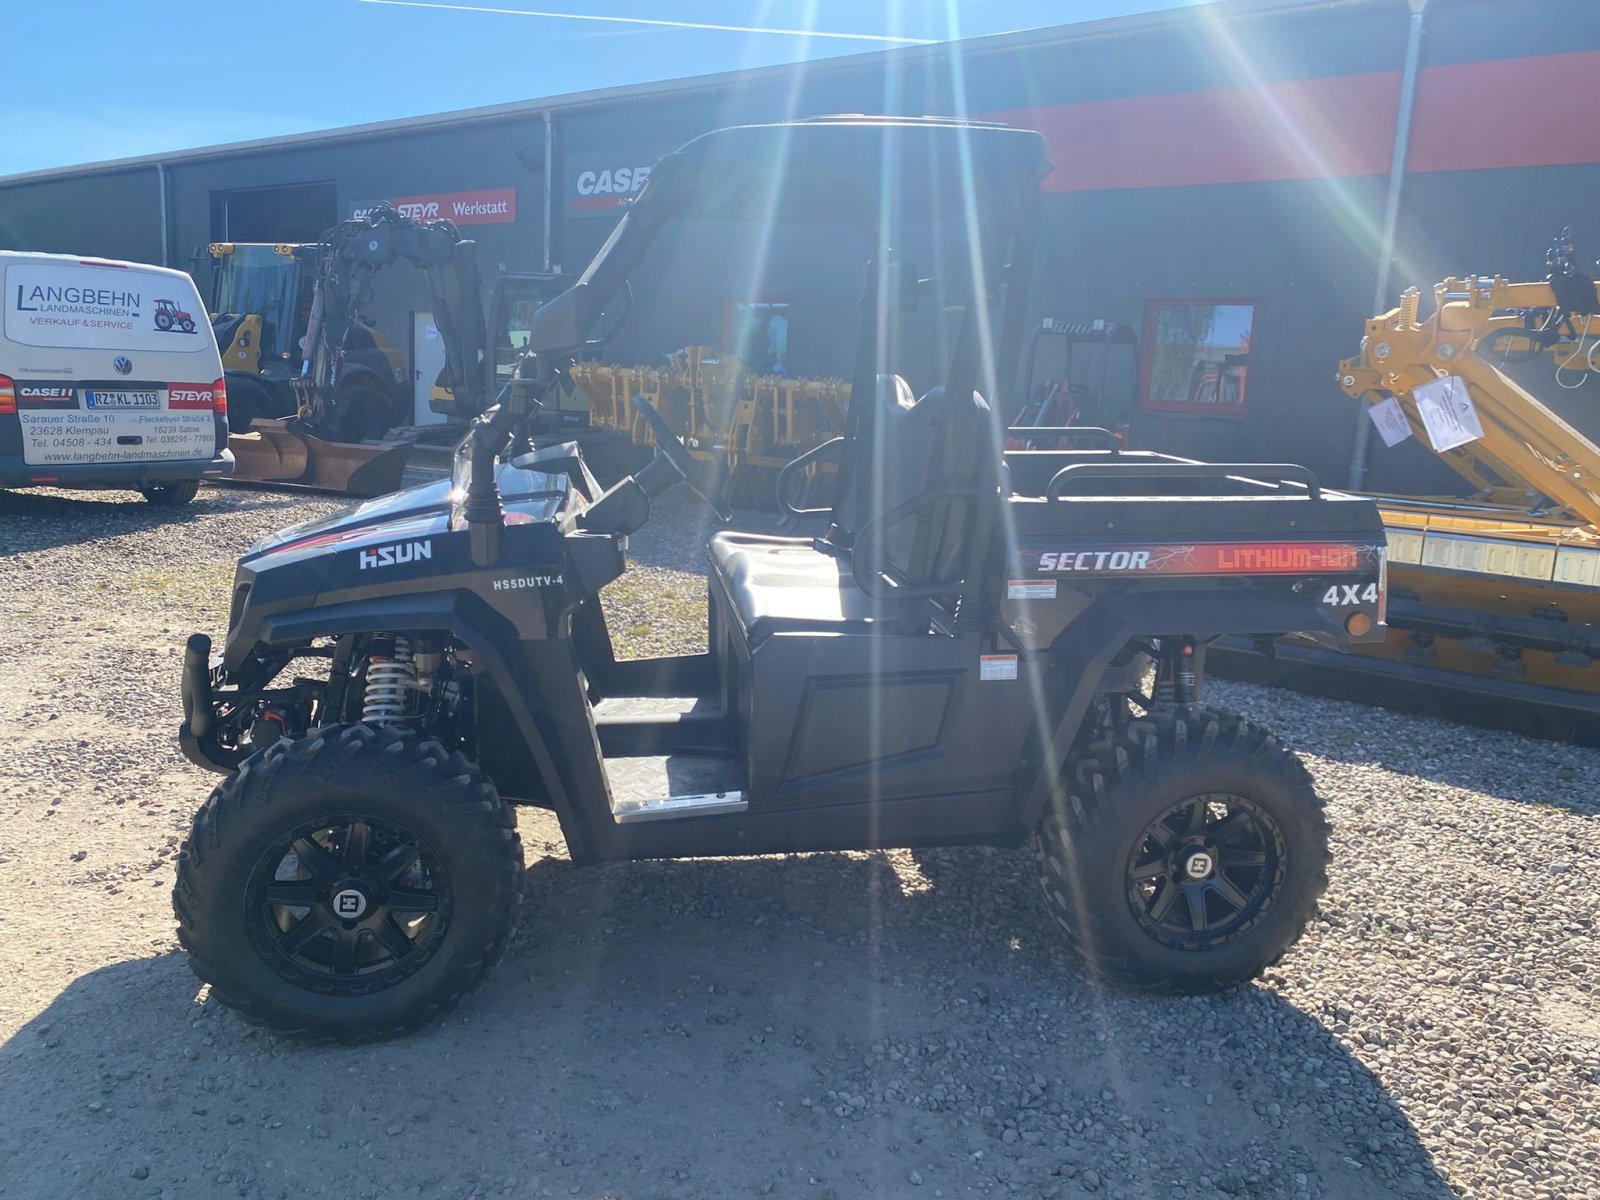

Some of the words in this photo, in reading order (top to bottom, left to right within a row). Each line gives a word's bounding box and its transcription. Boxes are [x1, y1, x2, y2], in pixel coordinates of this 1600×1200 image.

[398, 202, 439, 218] STEYR
[453, 200, 508, 216] Werkstatt
[17, 285, 140, 312] LANGBEHN
[40, 304, 129, 317] LANDMASCHINEN
[30, 317, 81, 326] VERKAUF
[83, 318, 89, 327] &
[90, 320, 133, 330] SERVICE
[20, 388, 59, 397] CASE
[170, 390, 213, 402] STEYR
[95, 393, 109, 405] RZ
[117, 393, 131, 405] KL
[133, 393, 158, 405] 1103
[22, 415, 63, 423] Sarauer
[67, 414, 99, 423] Straße
[103, 414, 115, 423] 10
[30, 427, 63, 435] 23628
[66, 427, 109, 436] Klempau
[154, 426, 177, 434] 18239
[178, 425, 200, 433] Satow
[32, 439, 49, 447] Tel.
[53, 439, 84, 447] 04508
[94, 438, 112, 446] 434
[160, 435, 188, 444] 038295
[1038, 551, 1150, 571] SECTOR
[493, 575, 563, 590] HS5DUTV-4
[1322, 583, 1378, 606] 4X4
